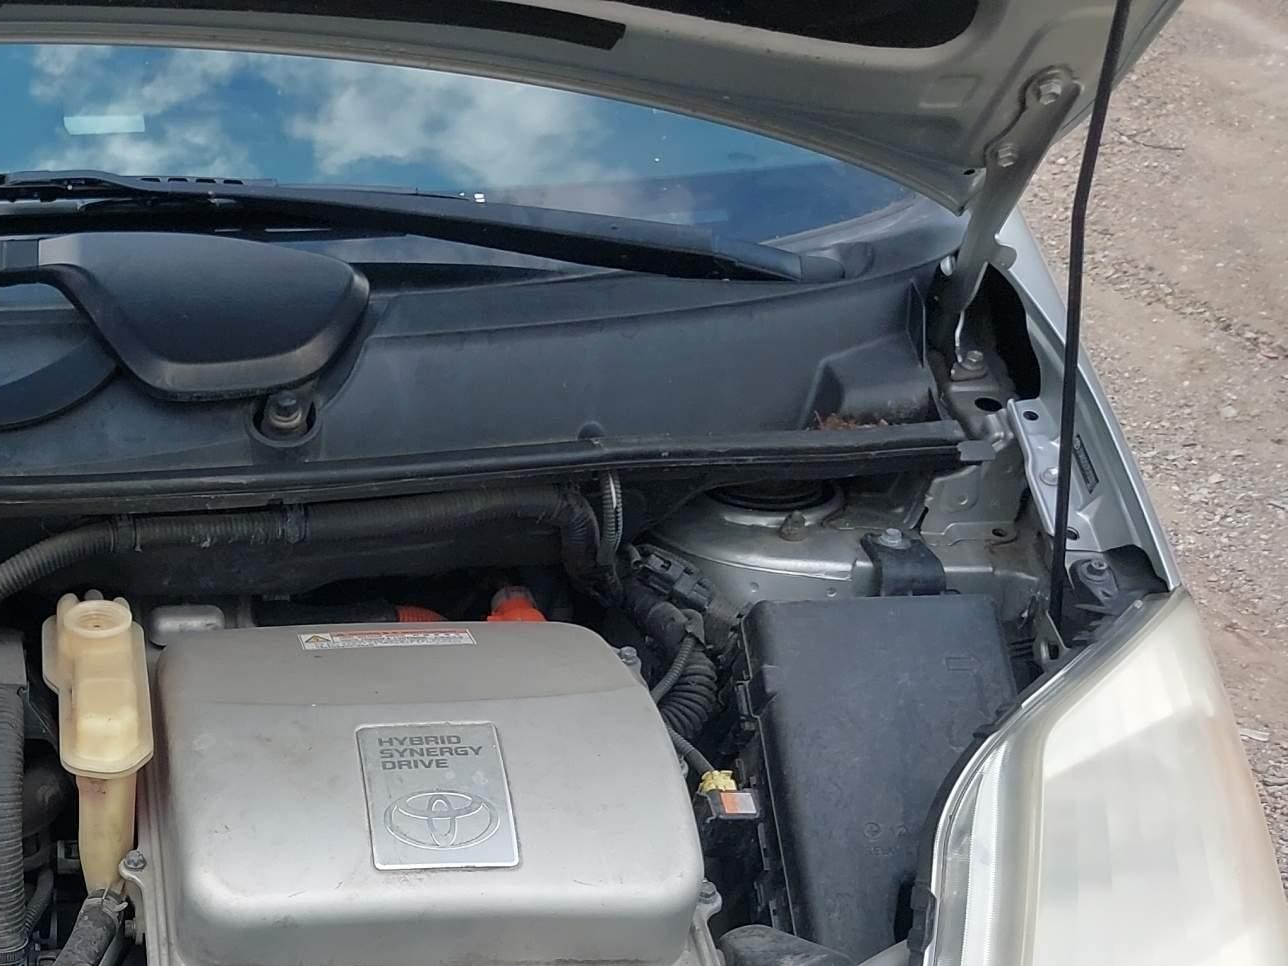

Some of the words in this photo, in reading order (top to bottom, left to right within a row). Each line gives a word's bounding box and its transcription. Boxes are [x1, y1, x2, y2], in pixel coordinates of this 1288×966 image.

[378, 735, 462, 747] HYBRID
[379, 746, 483, 759] SYNERGY
[382, 758, 449, 770] DRIVE
